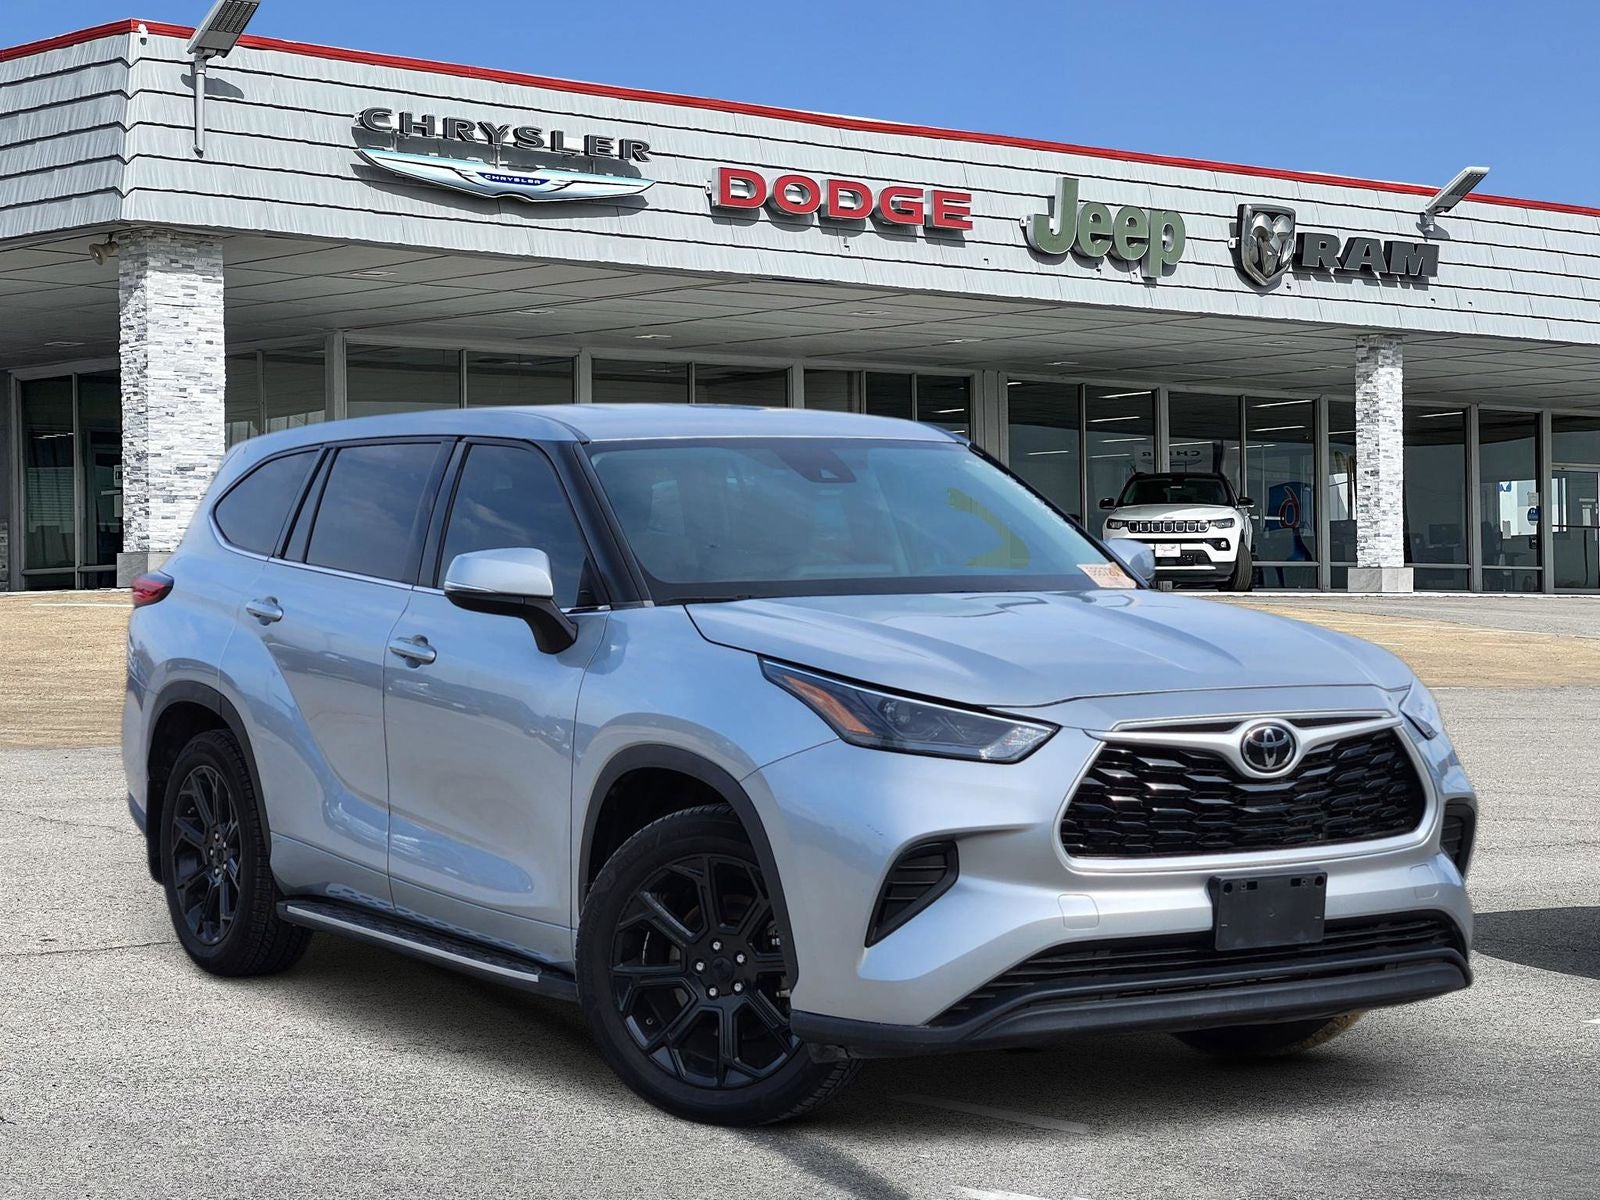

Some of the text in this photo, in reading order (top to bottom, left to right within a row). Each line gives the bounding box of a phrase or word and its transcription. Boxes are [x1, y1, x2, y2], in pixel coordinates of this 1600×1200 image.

[358, 107, 651, 162] CHRYSLER
[484, 174, 541, 185] CHRYSLER
[713, 167, 974, 232] DODGE
[1028, 177, 1187, 278] Jeep
[1296, 232, 1440, 277] RAM
